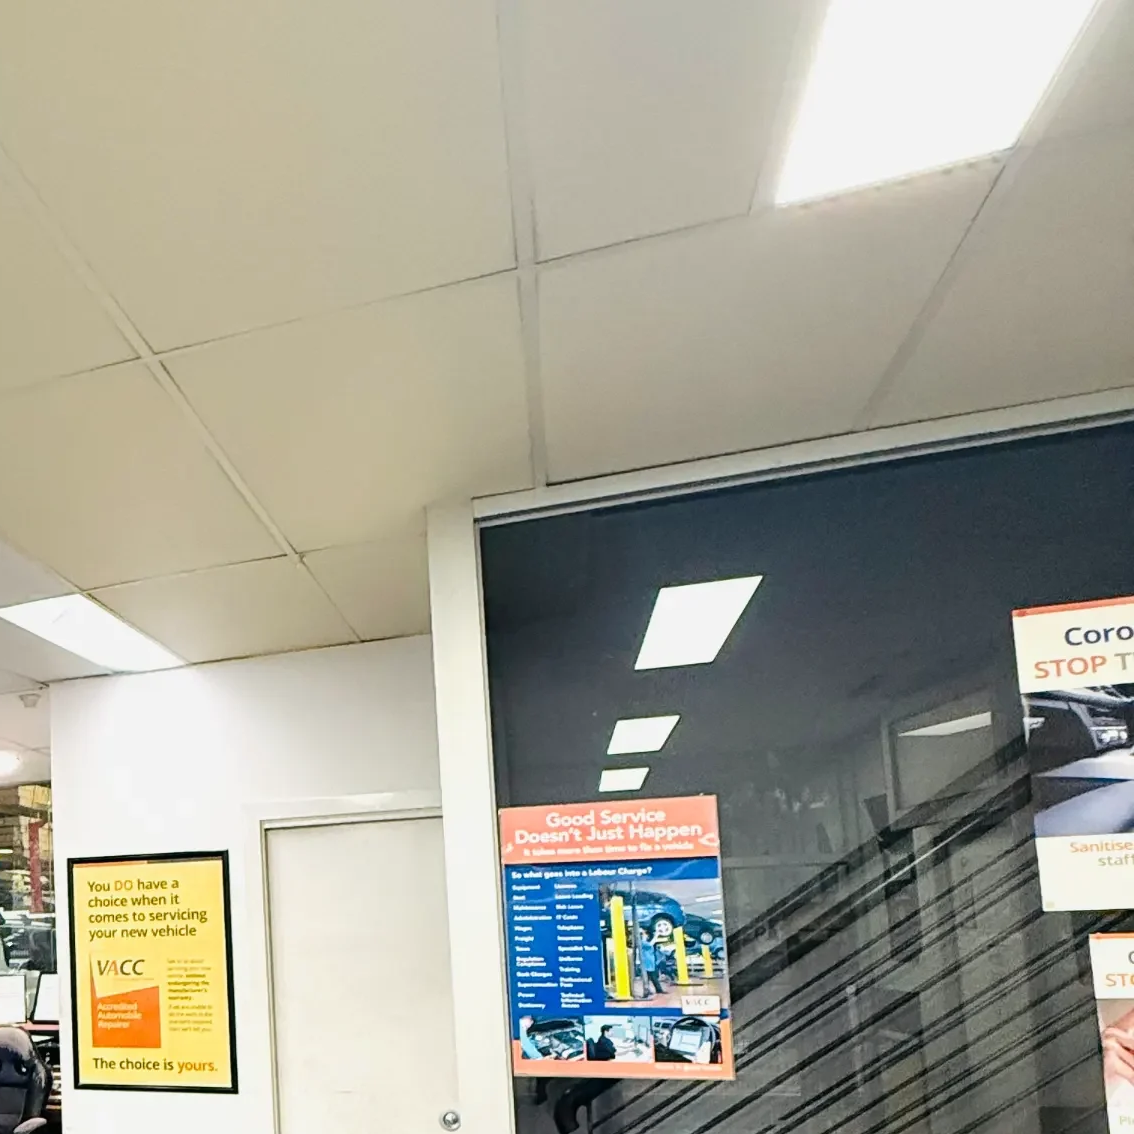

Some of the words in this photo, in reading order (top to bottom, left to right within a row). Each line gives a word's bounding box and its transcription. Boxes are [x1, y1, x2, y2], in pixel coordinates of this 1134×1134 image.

[1065, 626, 1134, 646] Coro
[1034, 655, 1107, 679] STOP
[1114, 652, 1134, 671] T
[546, 809, 595, 828] Good
[600, 807, 666, 825] Service
[515, 826, 582, 845] Doesn't
[586, 824, 626, 841] Just
[629, 823, 703, 841] Happen
[556, 846, 581, 855] more
[582, 844, 604, 854] than
[605, 844, 626, 853] time
[627, 844, 639, 852] to
[640, 842, 652, 851] fix
[662, 841, 694, 851] vehicle
[511, 871, 522, 880] So
[523, 869, 543, 879] what
[544, 870, 564, 880] goes
[565, 869, 580, 878] into
[588, 867, 616, 877] Labour
[618, 866, 652, 877] Charge?
[87, 880, 110, 892] You
[114, 880, 133, 891] DO
[137, 878, 168, 891] have
[171, 880, 179, 889] a
[88, 895, 128, 907] choice
[130, 894, 166, 906] when
[170, 893, 180, 904] it
[88, 913, 129, 923] comes
[132, 911, 145, 922] to
[149, 908, 208, 924] servicing
[89, 929, 117, 942] your
[121, 928, 148, 938] new
[151, 924, 197, 937] vehicle
[97, 958, 145, 976] VACC
[93, 1058, 116, 1069] The
[119, 1058, 160, 1070] choice
[163, 1058, 174, 1070] is
[177, 1060, 218, 1074] yours.
